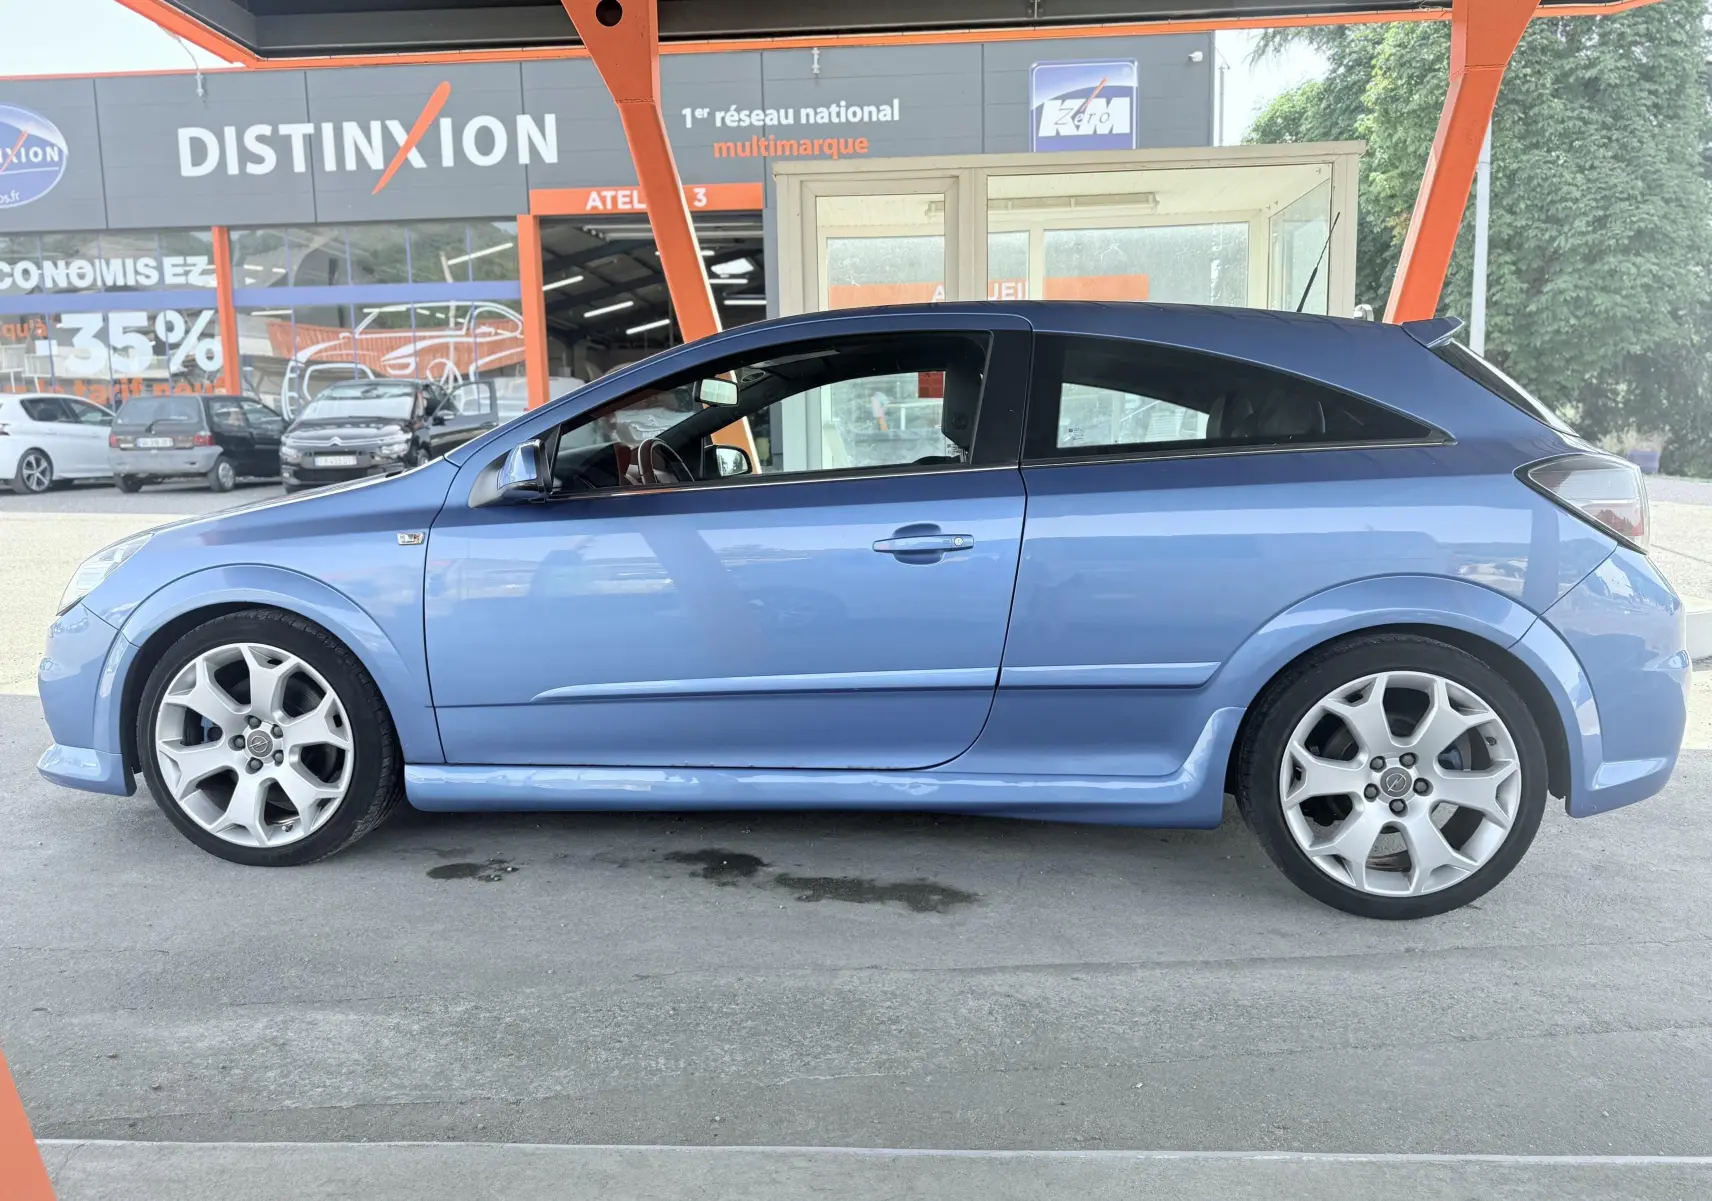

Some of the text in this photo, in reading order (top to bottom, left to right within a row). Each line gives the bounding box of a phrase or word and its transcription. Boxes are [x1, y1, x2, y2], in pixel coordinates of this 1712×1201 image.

[681, 98, 900, 129] 1er réseau national
[177, 82, 558, 195] DISTINXION
[713, 135, 870, 160] multimarque
[693, 187, 708, 208] 3
